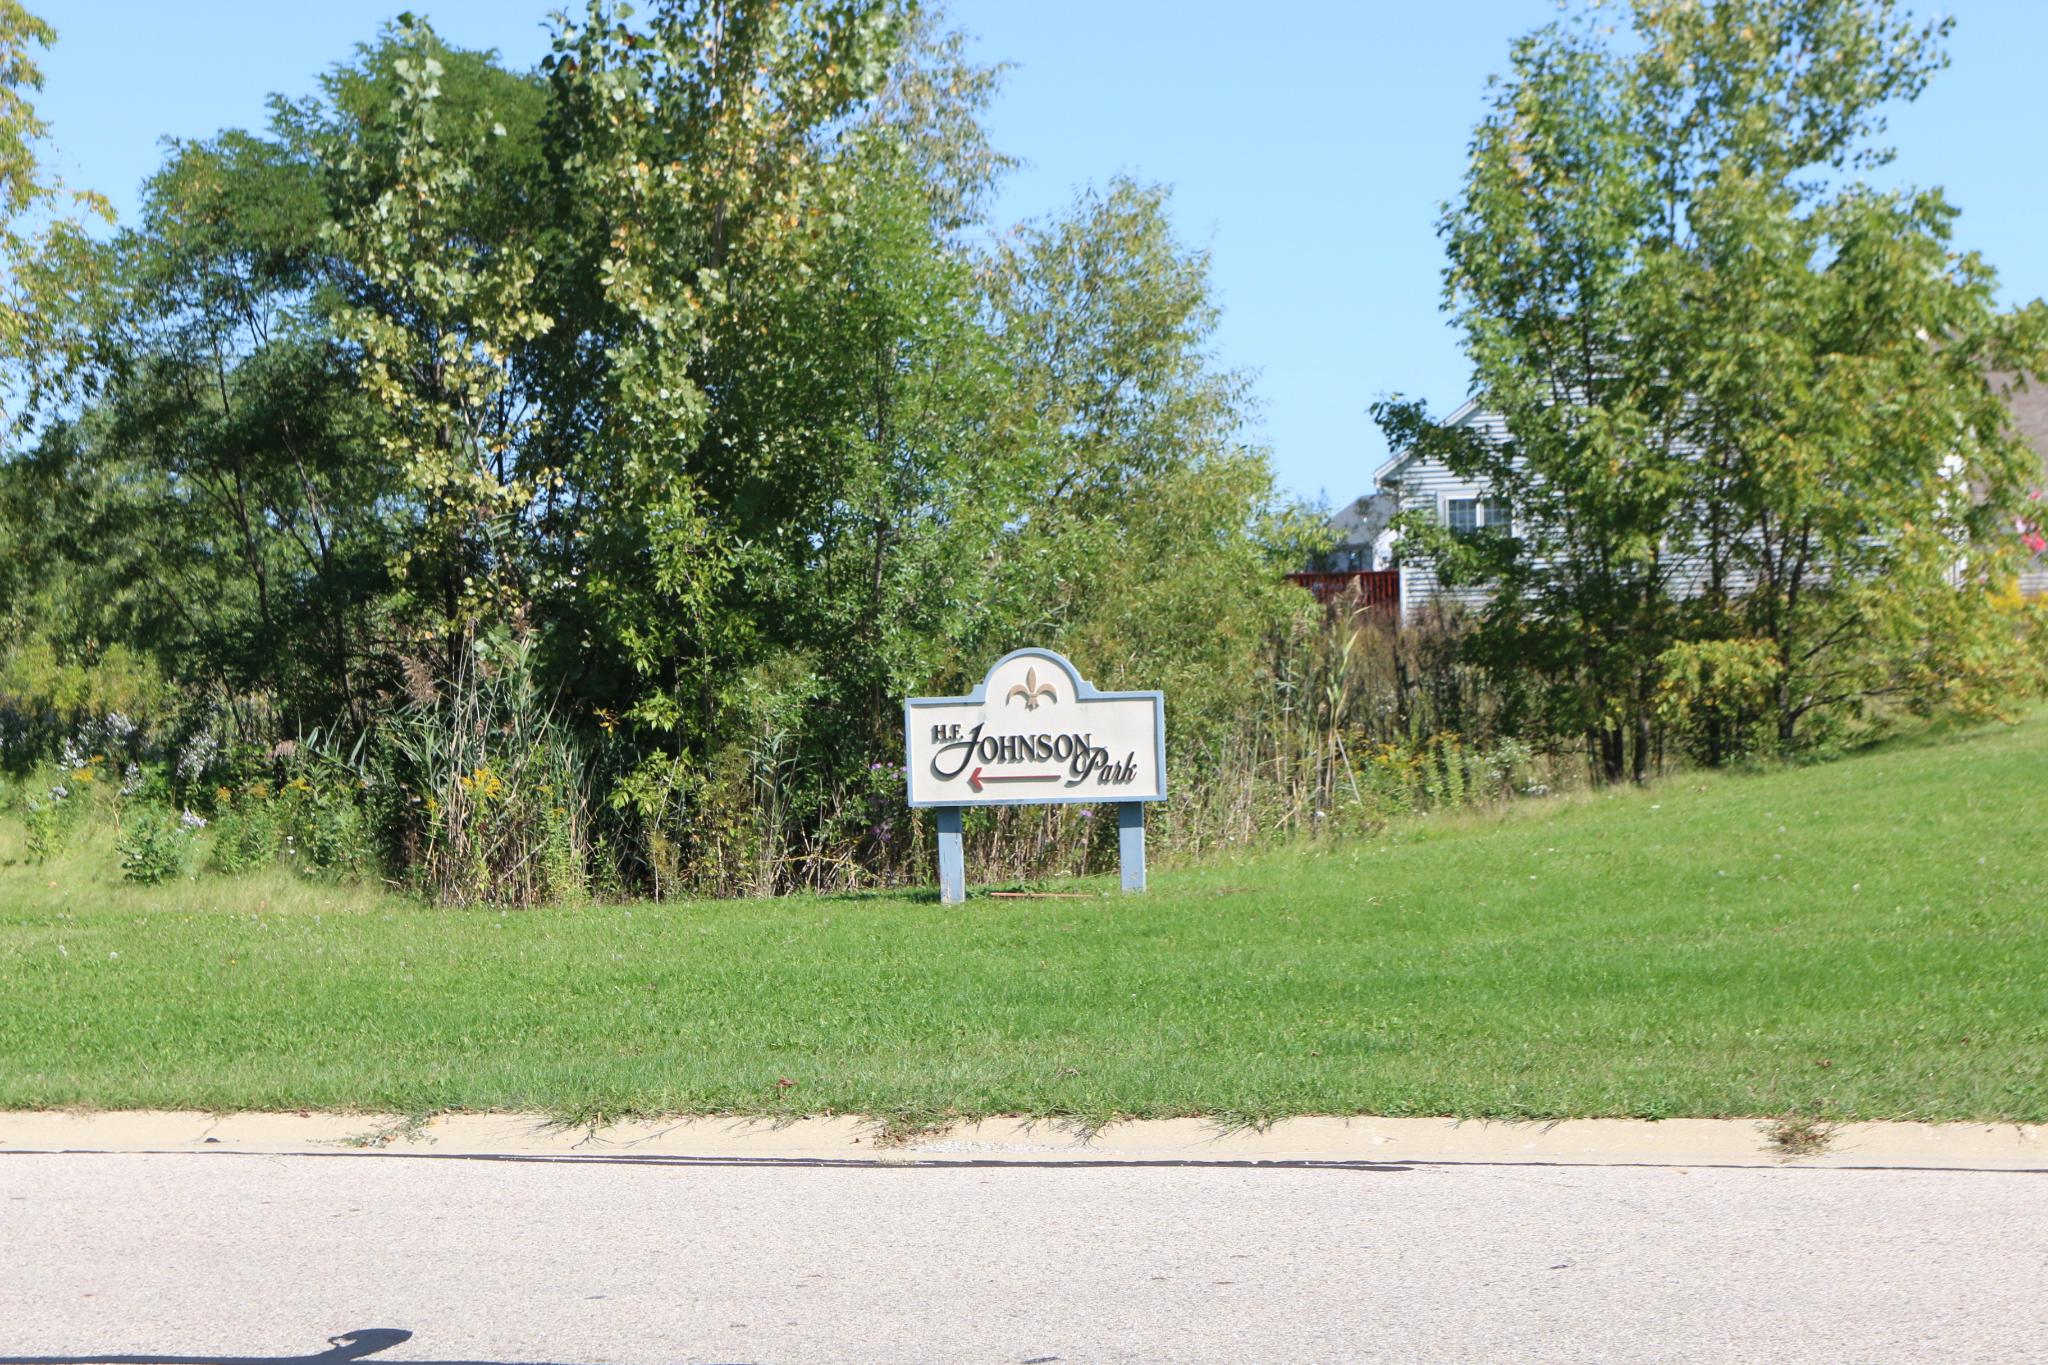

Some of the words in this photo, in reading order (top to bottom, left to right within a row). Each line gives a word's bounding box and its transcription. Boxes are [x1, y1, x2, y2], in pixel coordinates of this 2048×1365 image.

[932, 724, 964, 742] H.F.
[933, 722, 1092, 778] JOHNSON
[1066, 746, 1138, 786] Park
